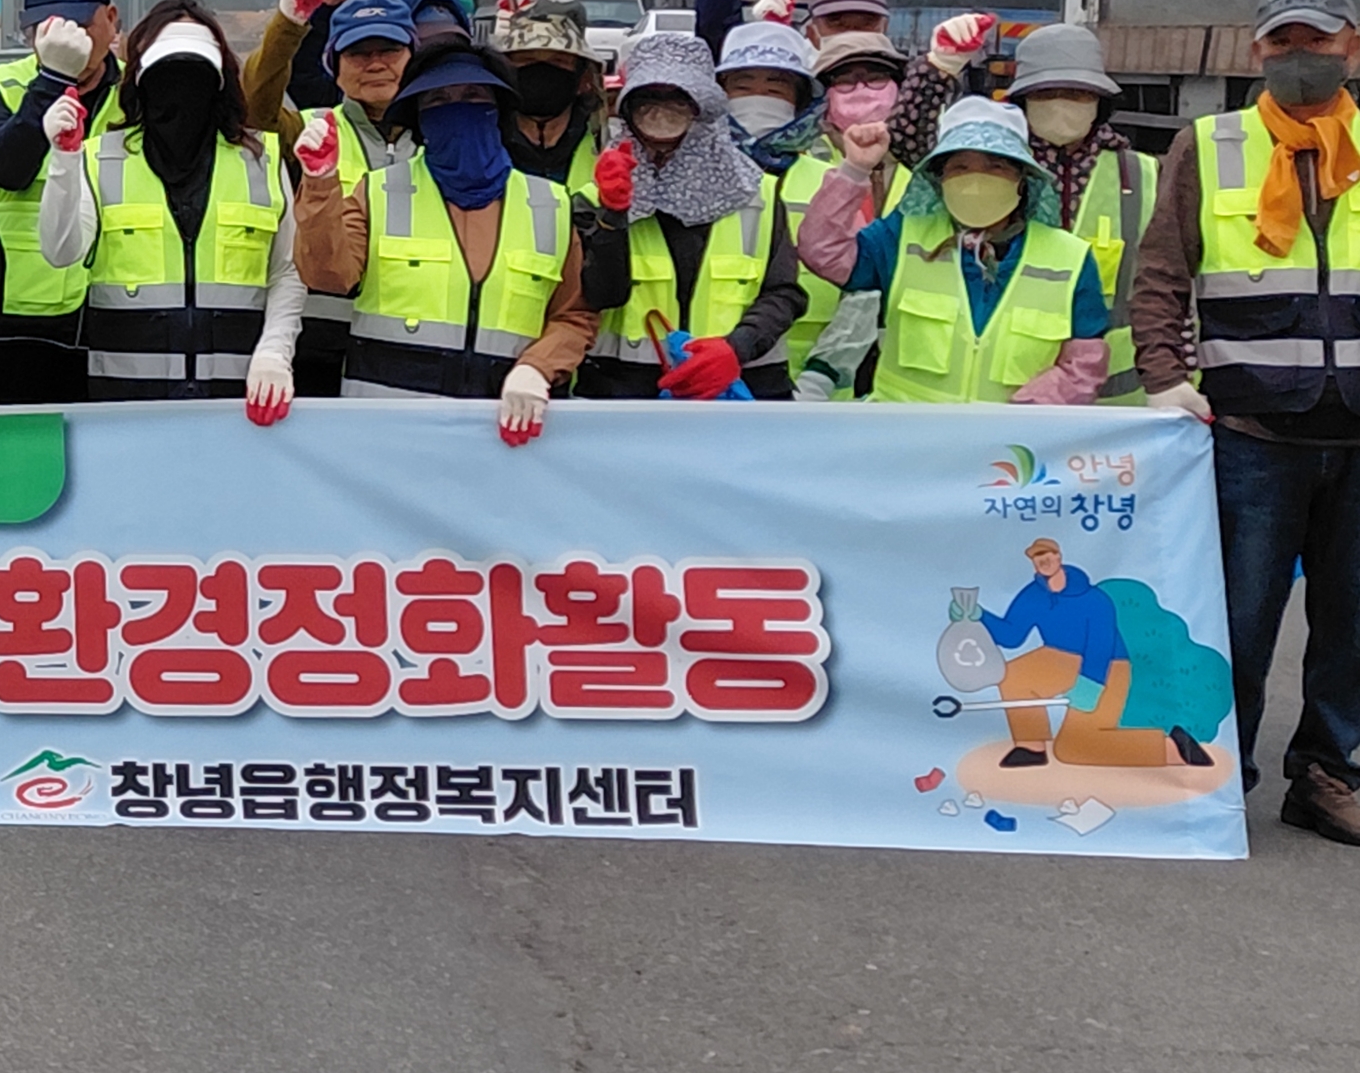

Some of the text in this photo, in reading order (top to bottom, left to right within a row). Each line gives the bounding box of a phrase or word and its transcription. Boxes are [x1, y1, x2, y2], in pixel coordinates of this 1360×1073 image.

[1067, 453, 1136, 487] 안녕
[984, 492, 1136, 532] 자연의 창녕
[110, 760, 699, 828] 창녕읍행정복지센터
